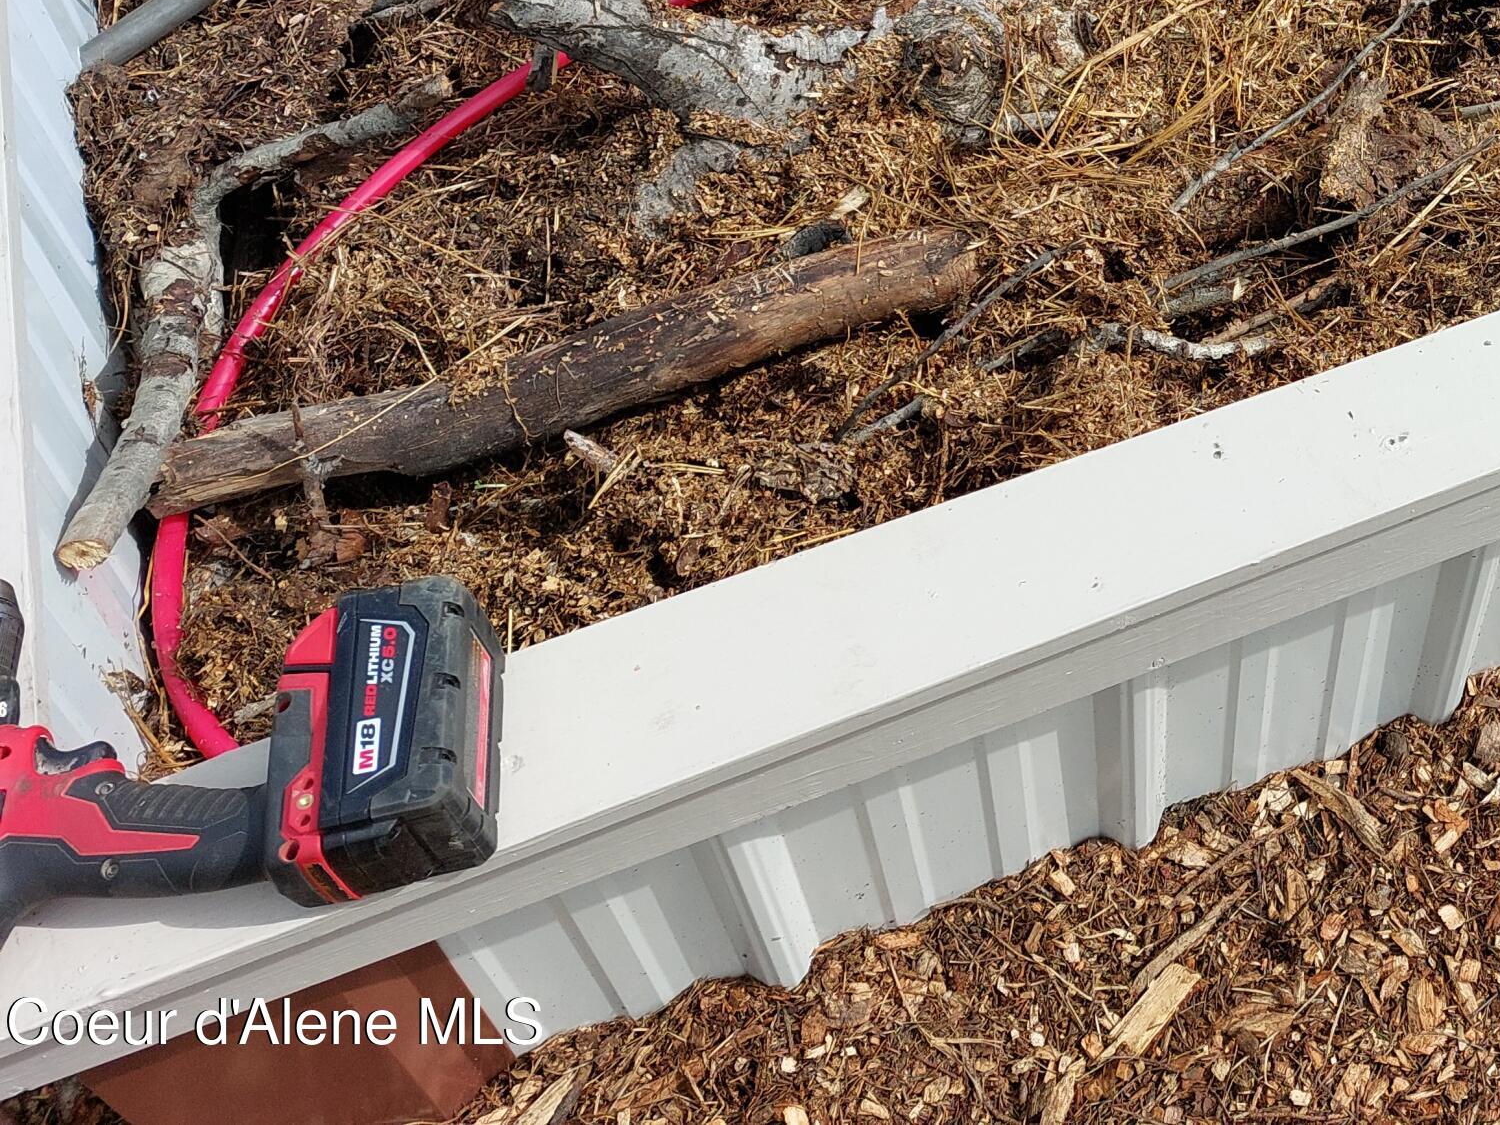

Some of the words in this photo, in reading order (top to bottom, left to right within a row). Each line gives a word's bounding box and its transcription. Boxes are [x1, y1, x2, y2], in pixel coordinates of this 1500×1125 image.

[363, 625, 382, 717] REDLITHIUM
[380, 626, 398, 684] XC5.0
[358, 723, 376, 770] M18
